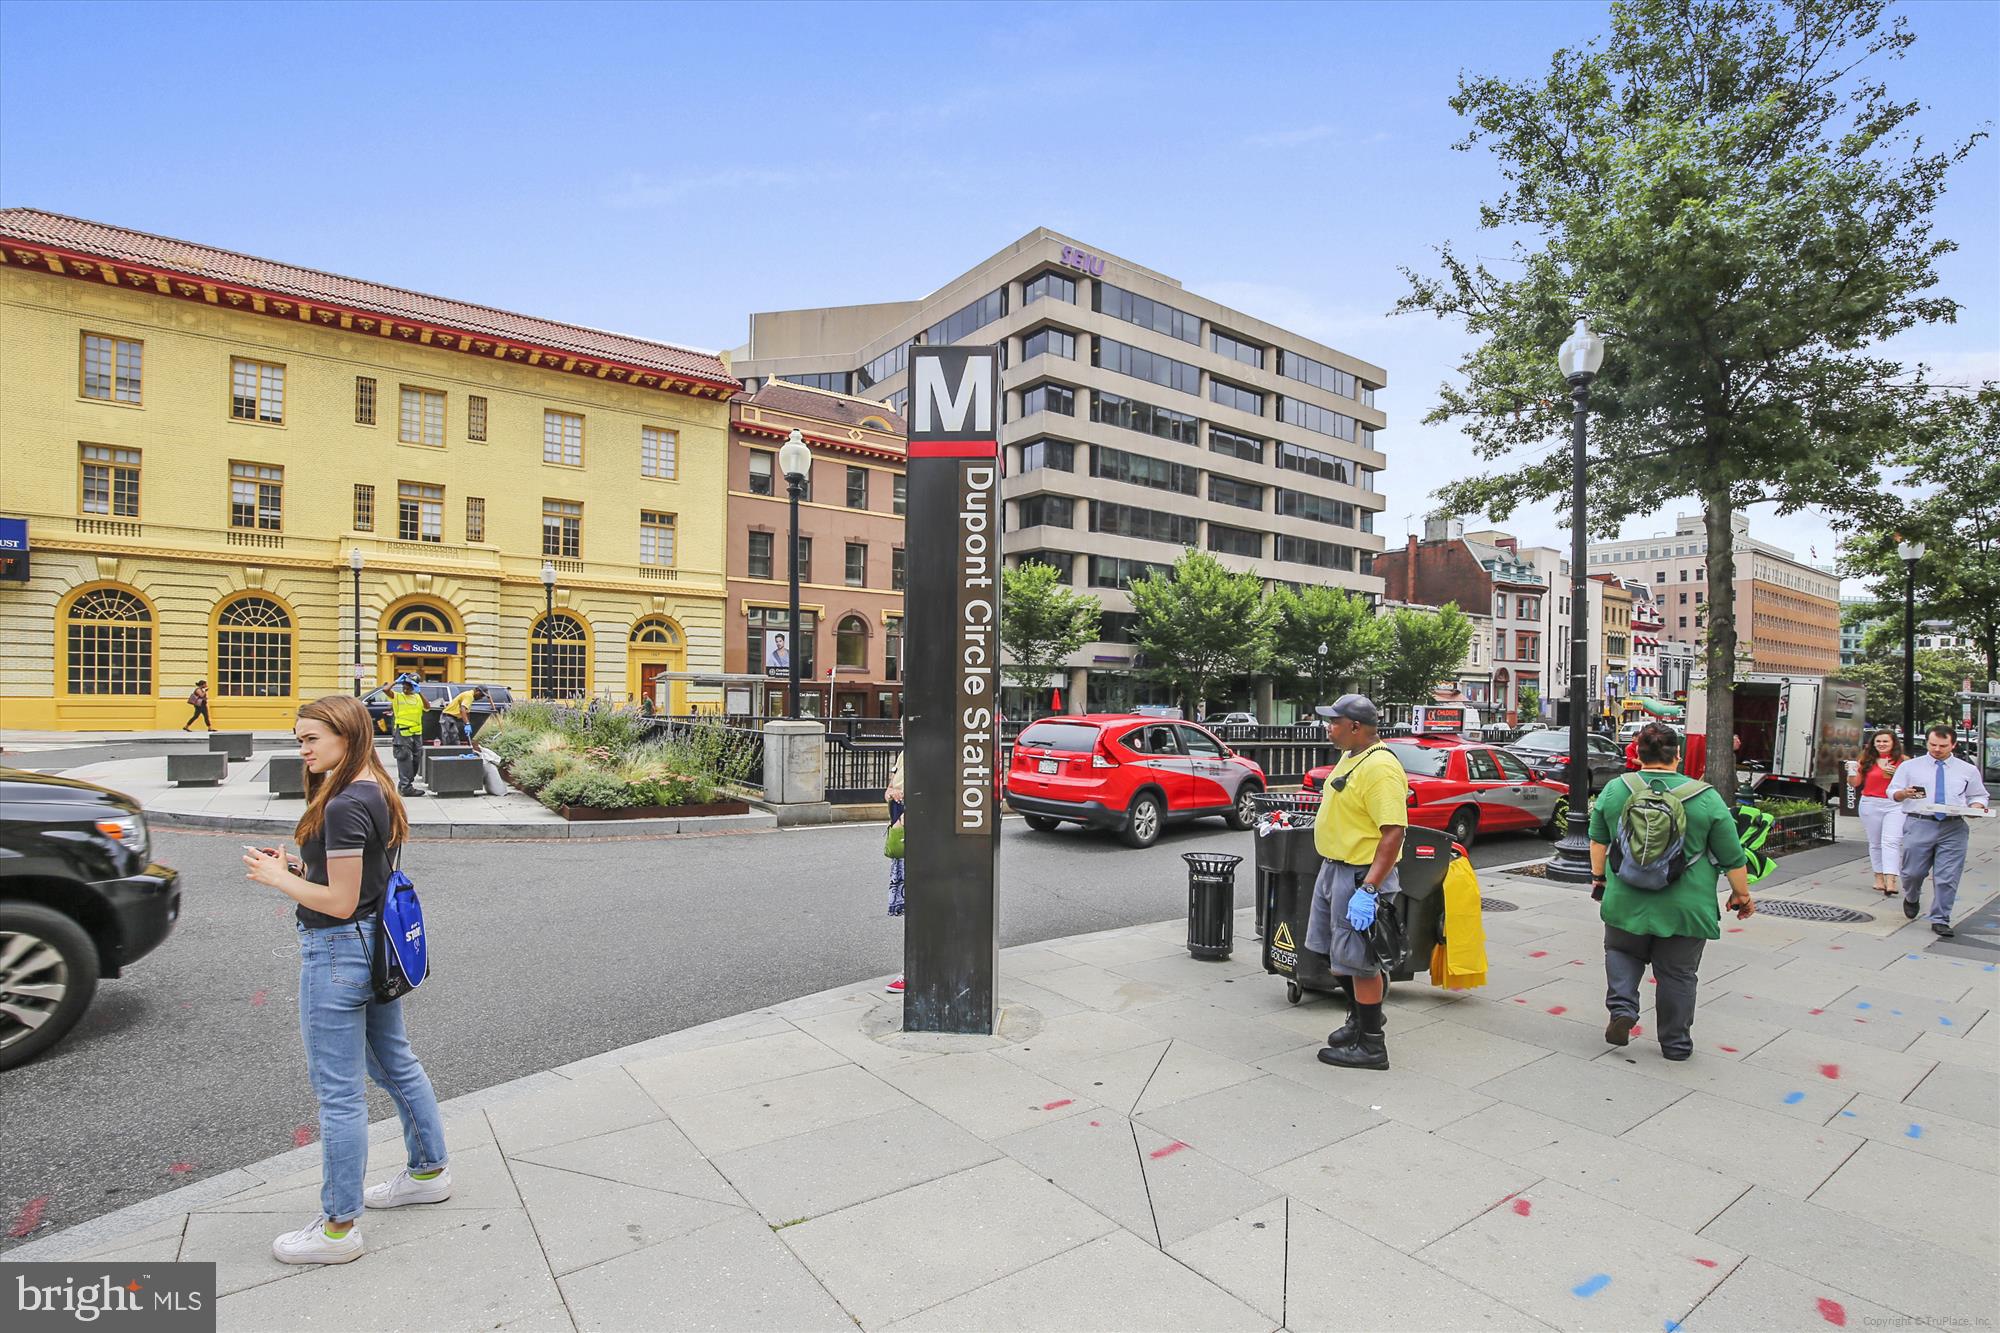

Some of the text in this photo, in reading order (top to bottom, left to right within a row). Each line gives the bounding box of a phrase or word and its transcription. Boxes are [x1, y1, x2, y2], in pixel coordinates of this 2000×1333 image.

[1060, 245, 1105, 276] SEIU
[914, 355, 992, 432] M
[960, 467, 994, 828] Dupont Circle Station
